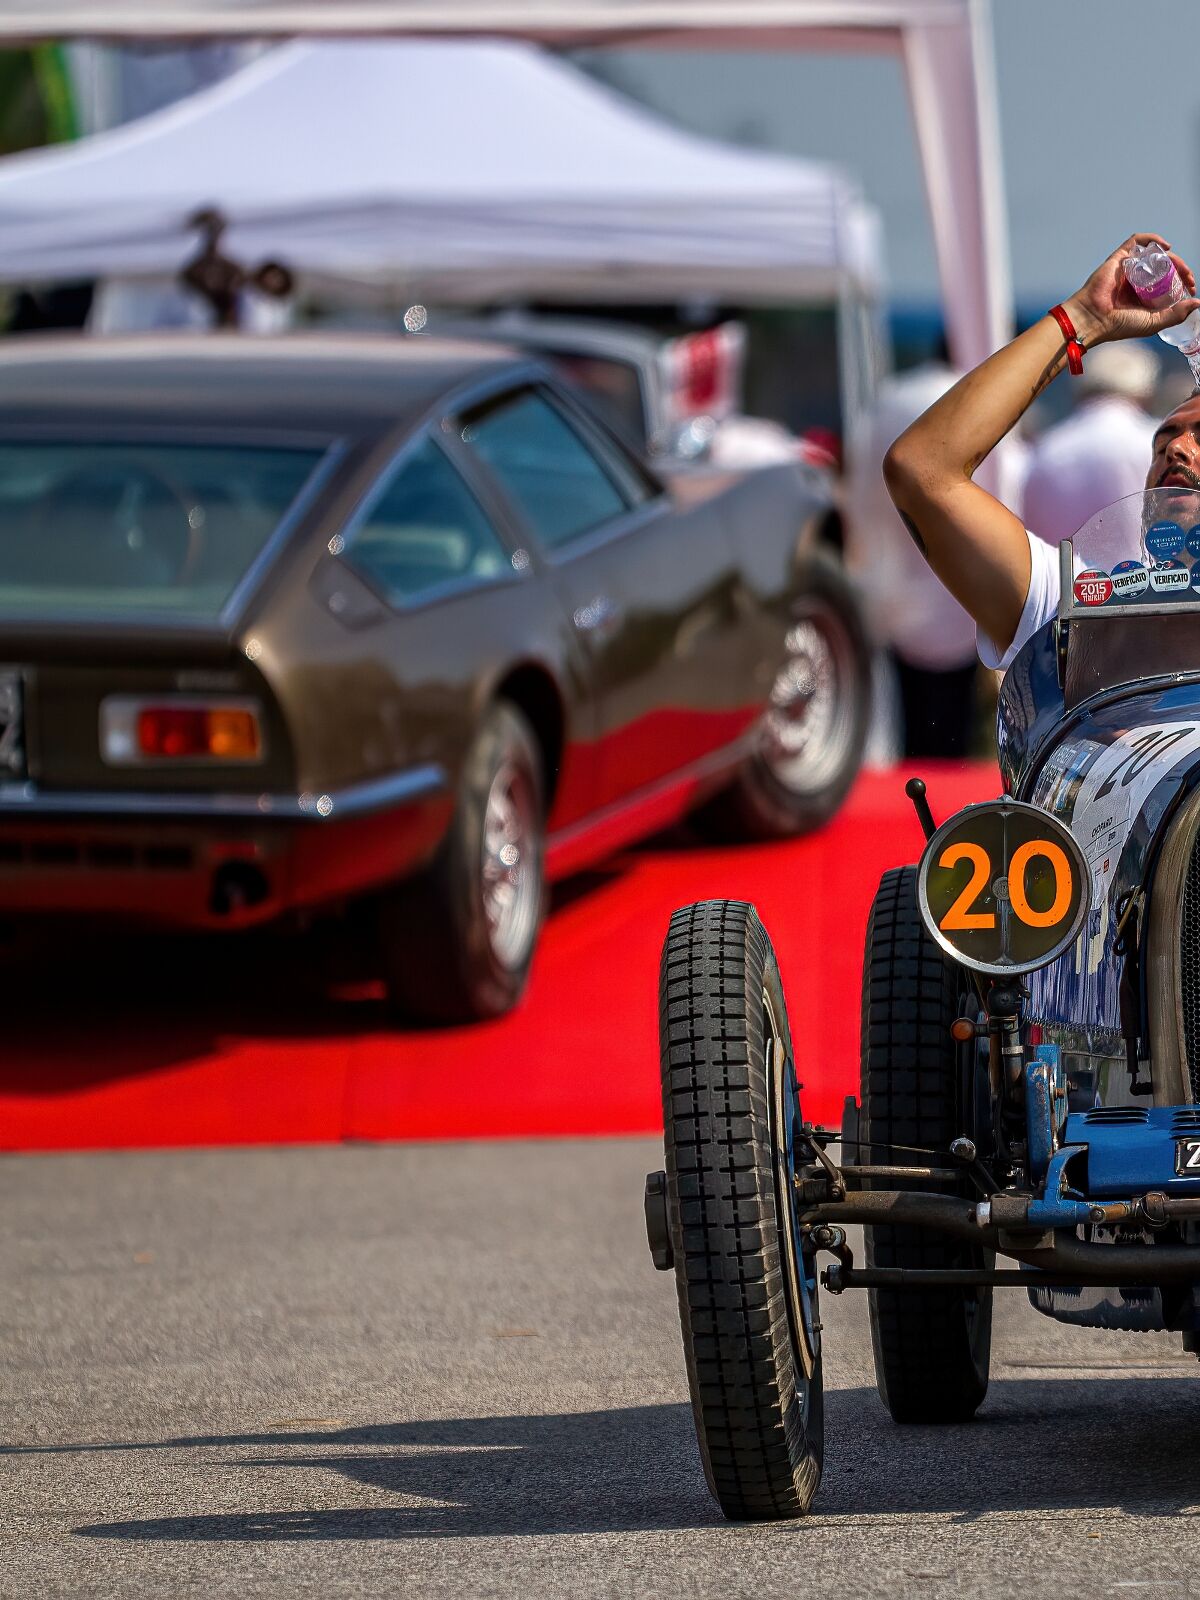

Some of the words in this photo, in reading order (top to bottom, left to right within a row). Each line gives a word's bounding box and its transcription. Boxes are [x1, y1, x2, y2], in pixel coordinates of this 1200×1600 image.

[1112, 572, 1147, 589] VERIFICATO
[1153, 573, 1189, 585] VERIFICATO
[1080, 584, 1107, 596] 2015
[1092, 727, 1196, 803] 20
[938, 839, 1073, 931] 20
